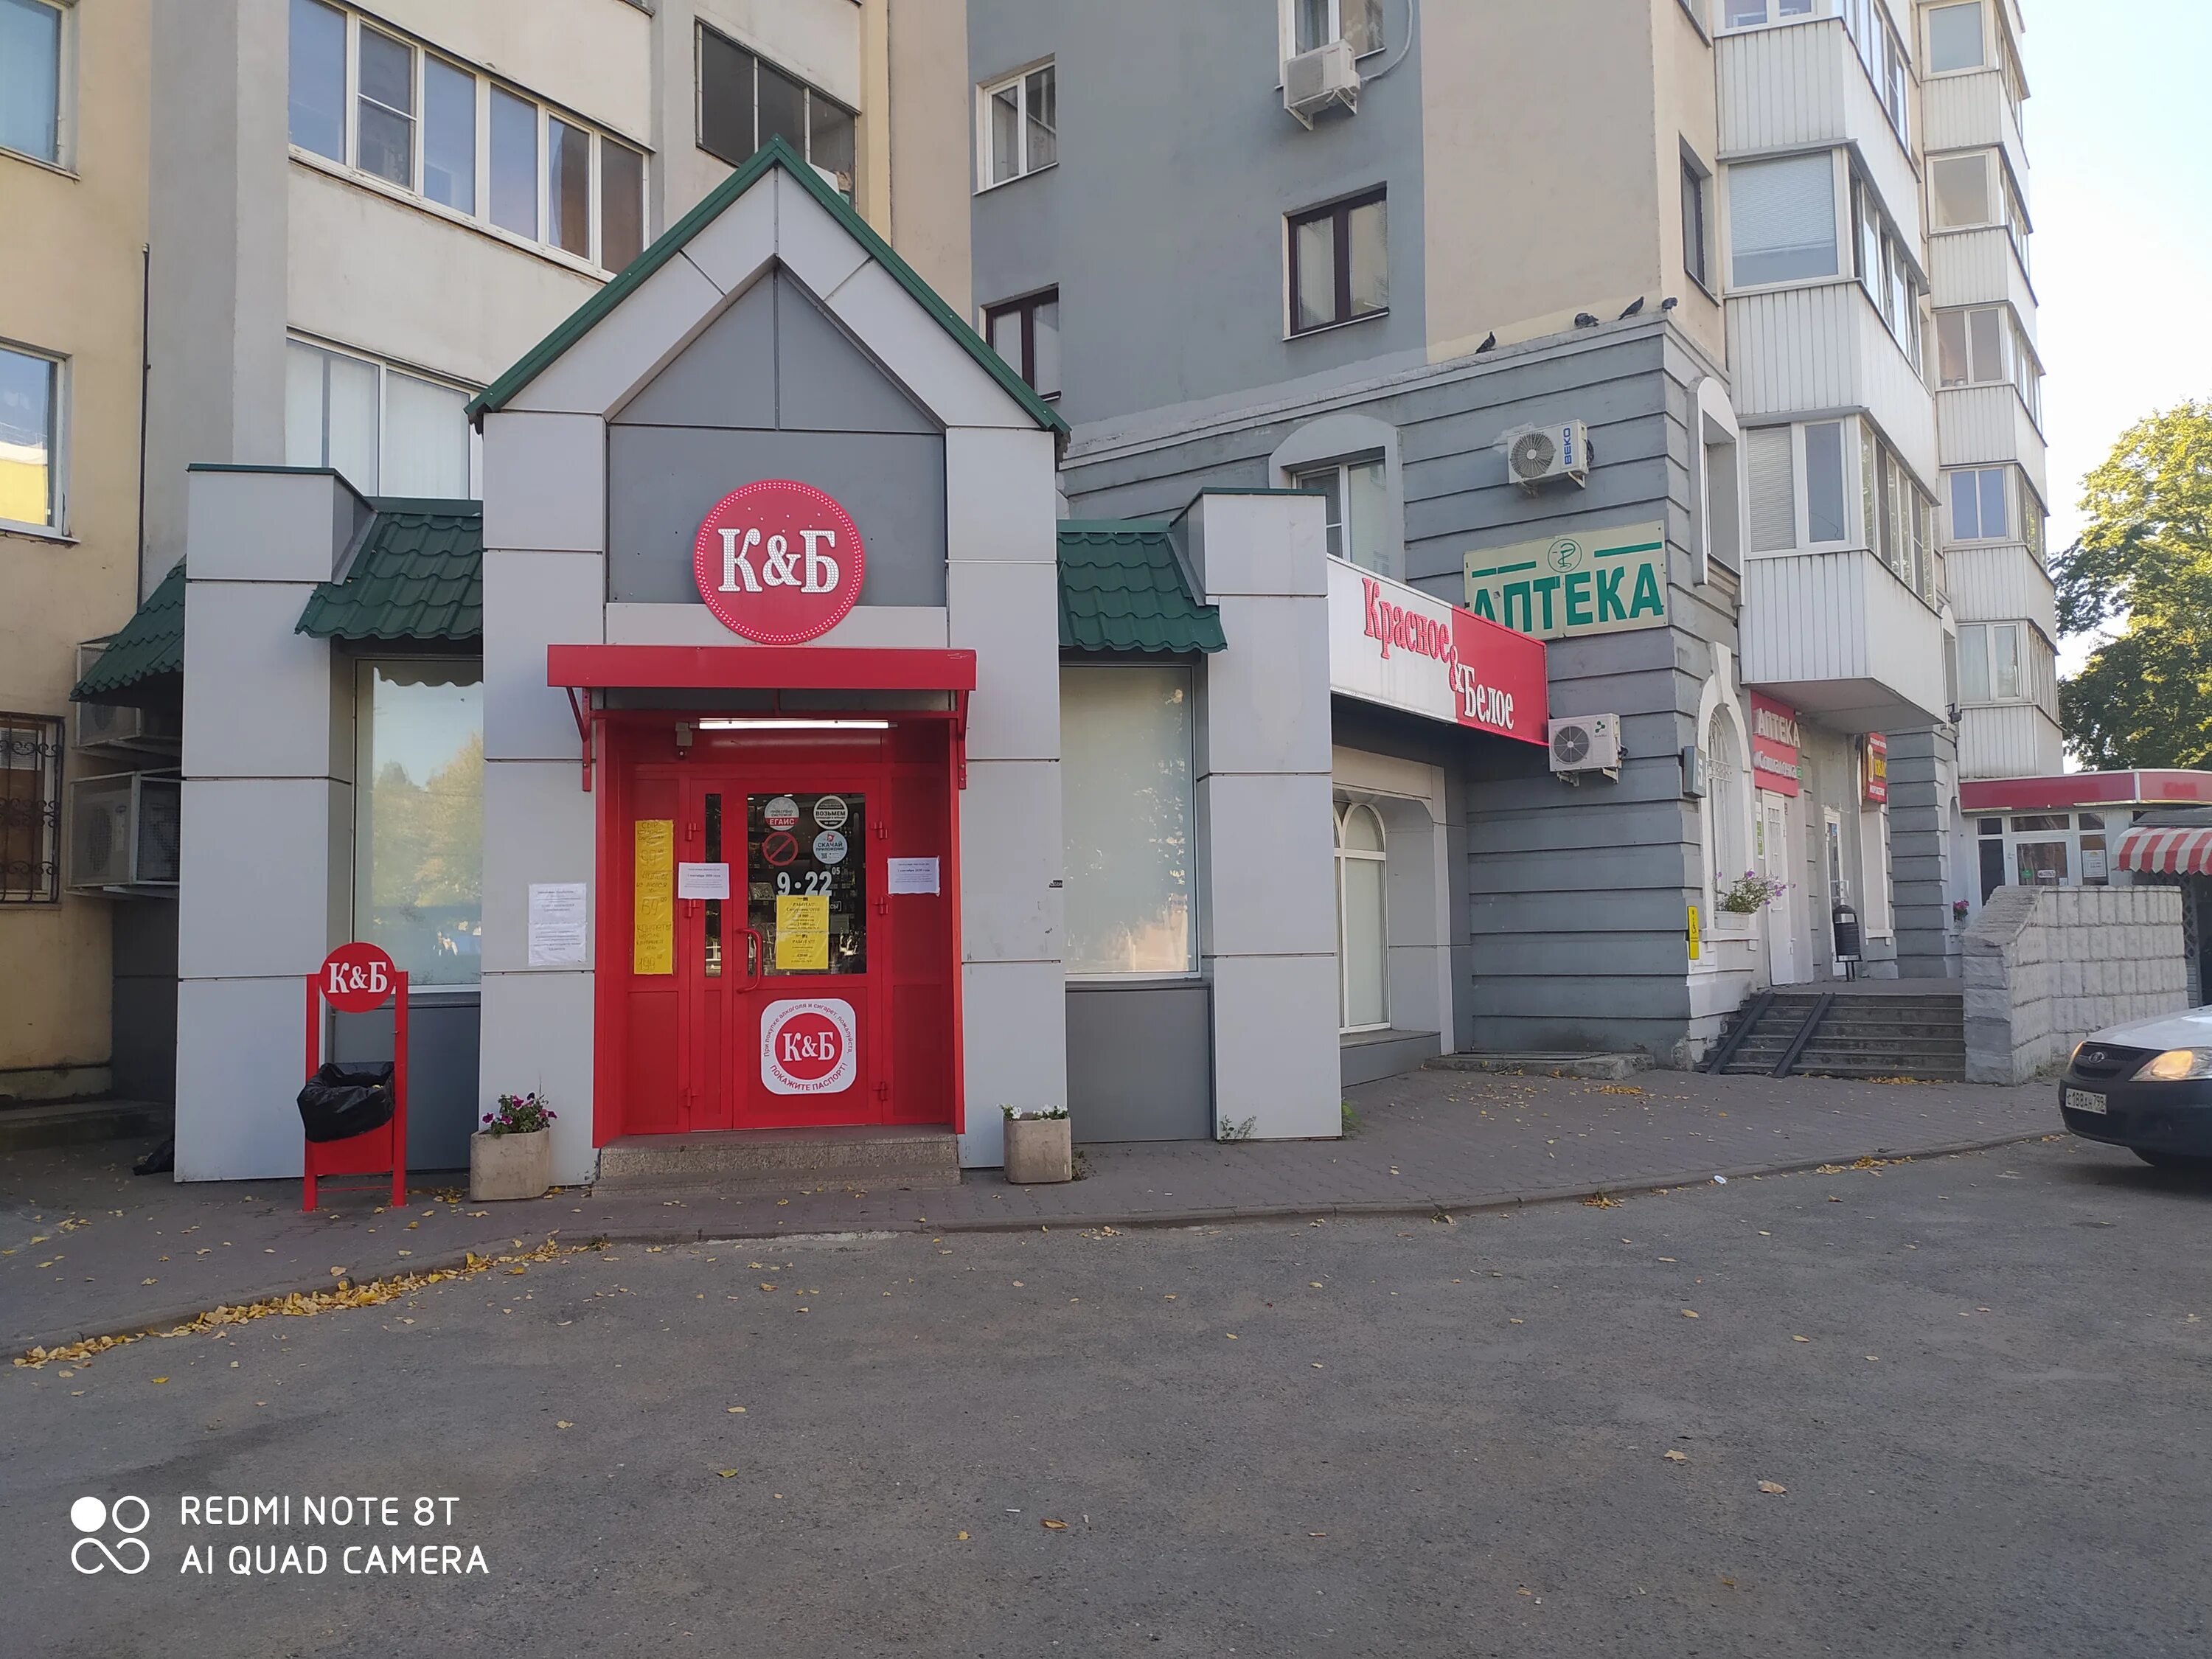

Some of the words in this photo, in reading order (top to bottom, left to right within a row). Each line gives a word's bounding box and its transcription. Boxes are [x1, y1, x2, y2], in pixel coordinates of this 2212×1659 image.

[1563, 428, 1572, 465] BEKO
[717, 527, 840, 593] К&Б
[1474, 563, 1664, 633] АПТЕКА
[1361, 577, 1450, 664] Красное
[1463, 665, 1514, 730] Белое
[1756, 707, 1801, 748] АПТЕКА
[769, 818, 796, 826] ЕГАИС
[832, 867, 841, 875] 05
[327, 961, 389, 995] К&Б
[765, 1018, 780, 1043] покупке
[779, 1003, 807, 1019] алкоголя
[813, 1004, 838, 1018] сигарет,
[837, 1016, 853, 1054] пожалуйста,
[782, 1032, 835, 1062] К&Б
[769, 1064, 810, 1091] ПОКАЖИТЕ
[812, 1062, 848, 1091] ПАСПОРТ!
